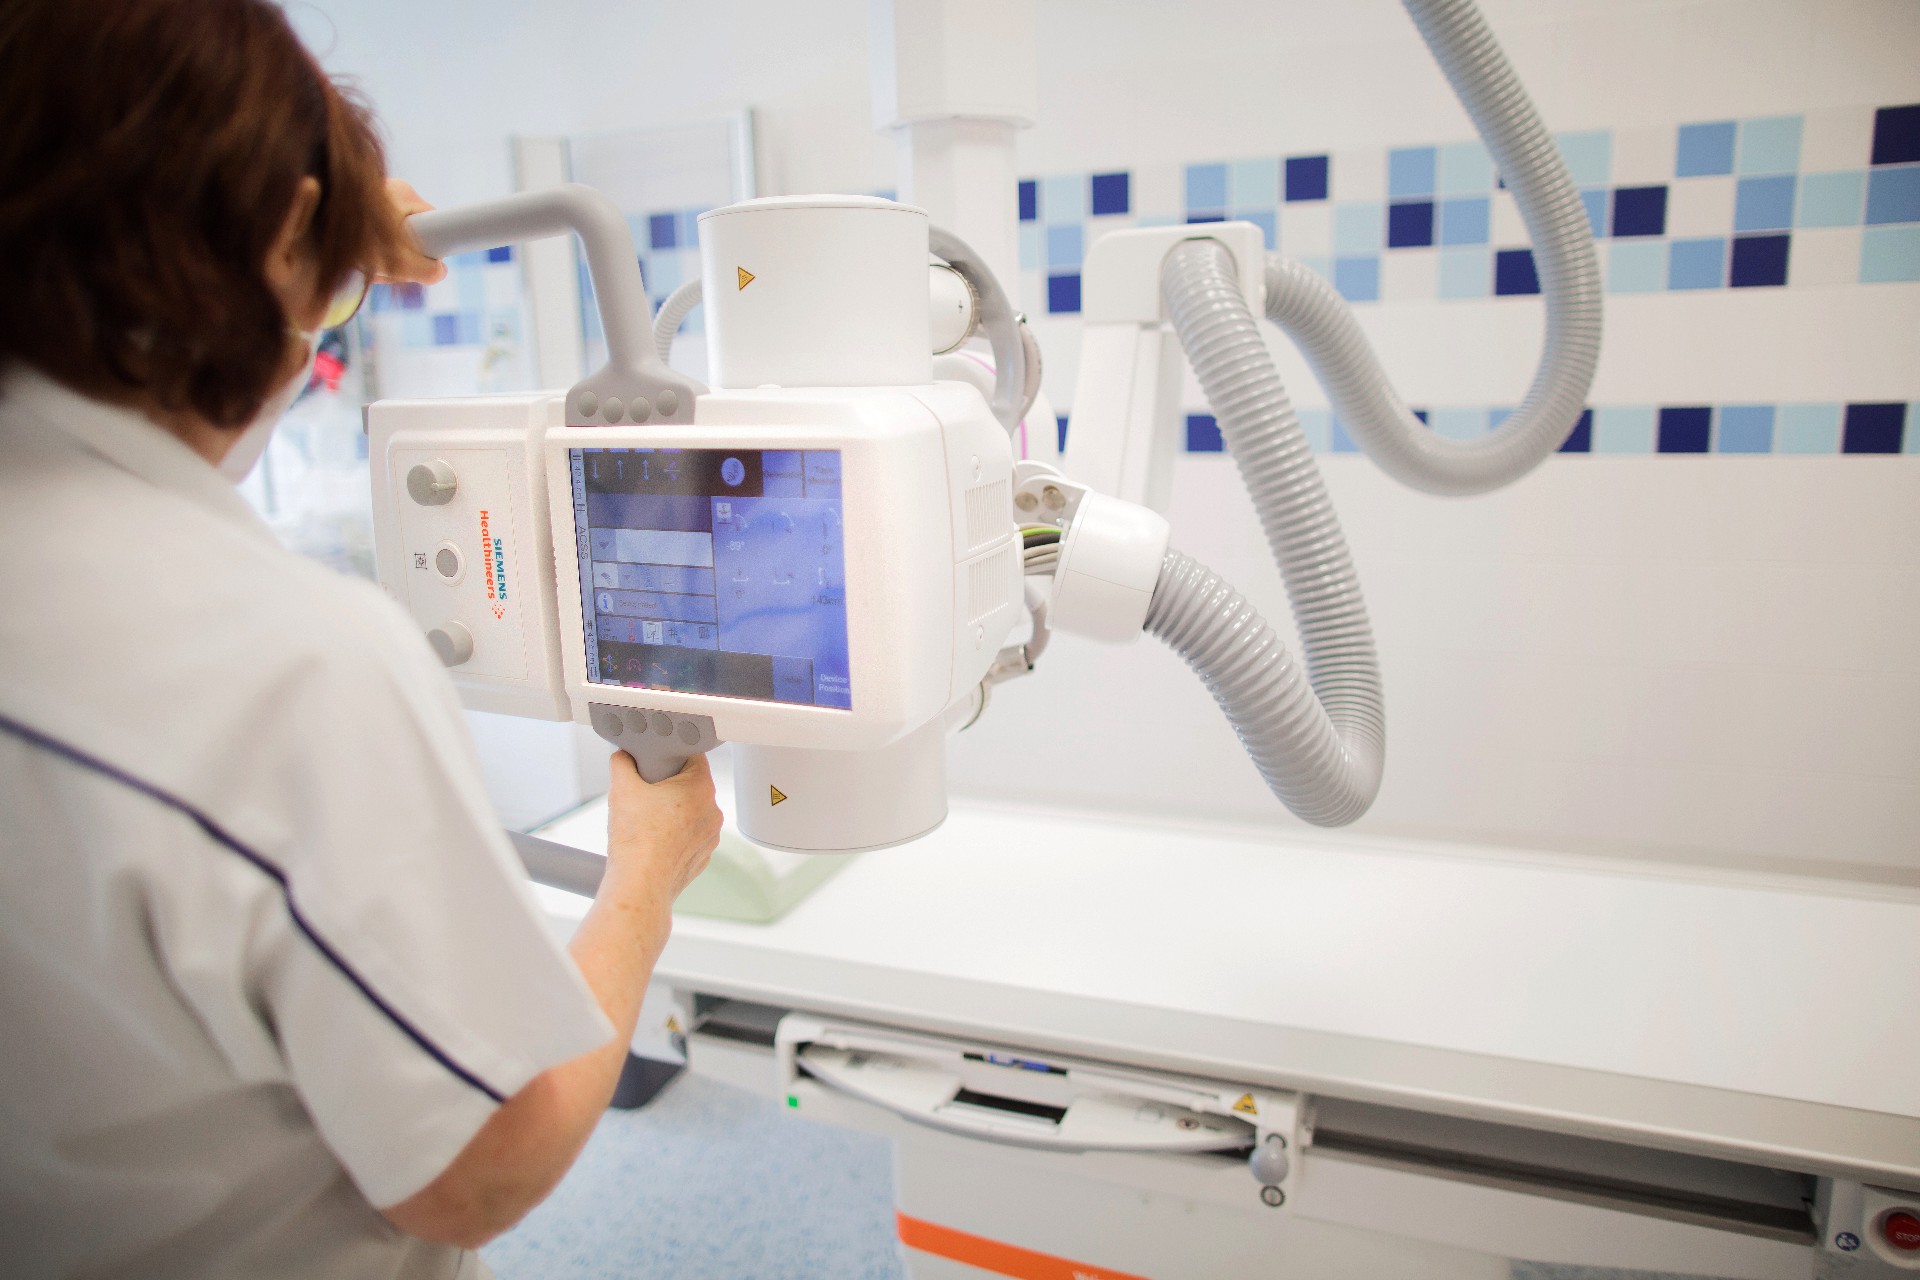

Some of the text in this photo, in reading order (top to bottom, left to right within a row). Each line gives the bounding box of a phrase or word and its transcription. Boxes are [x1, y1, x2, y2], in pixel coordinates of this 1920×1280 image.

[480, 510, 495, 599] Healthineers
[494, 538, 507, 600] SIEMENS
[818, 684, 850, 695] Position
[820, 673, 848, 684] Device
